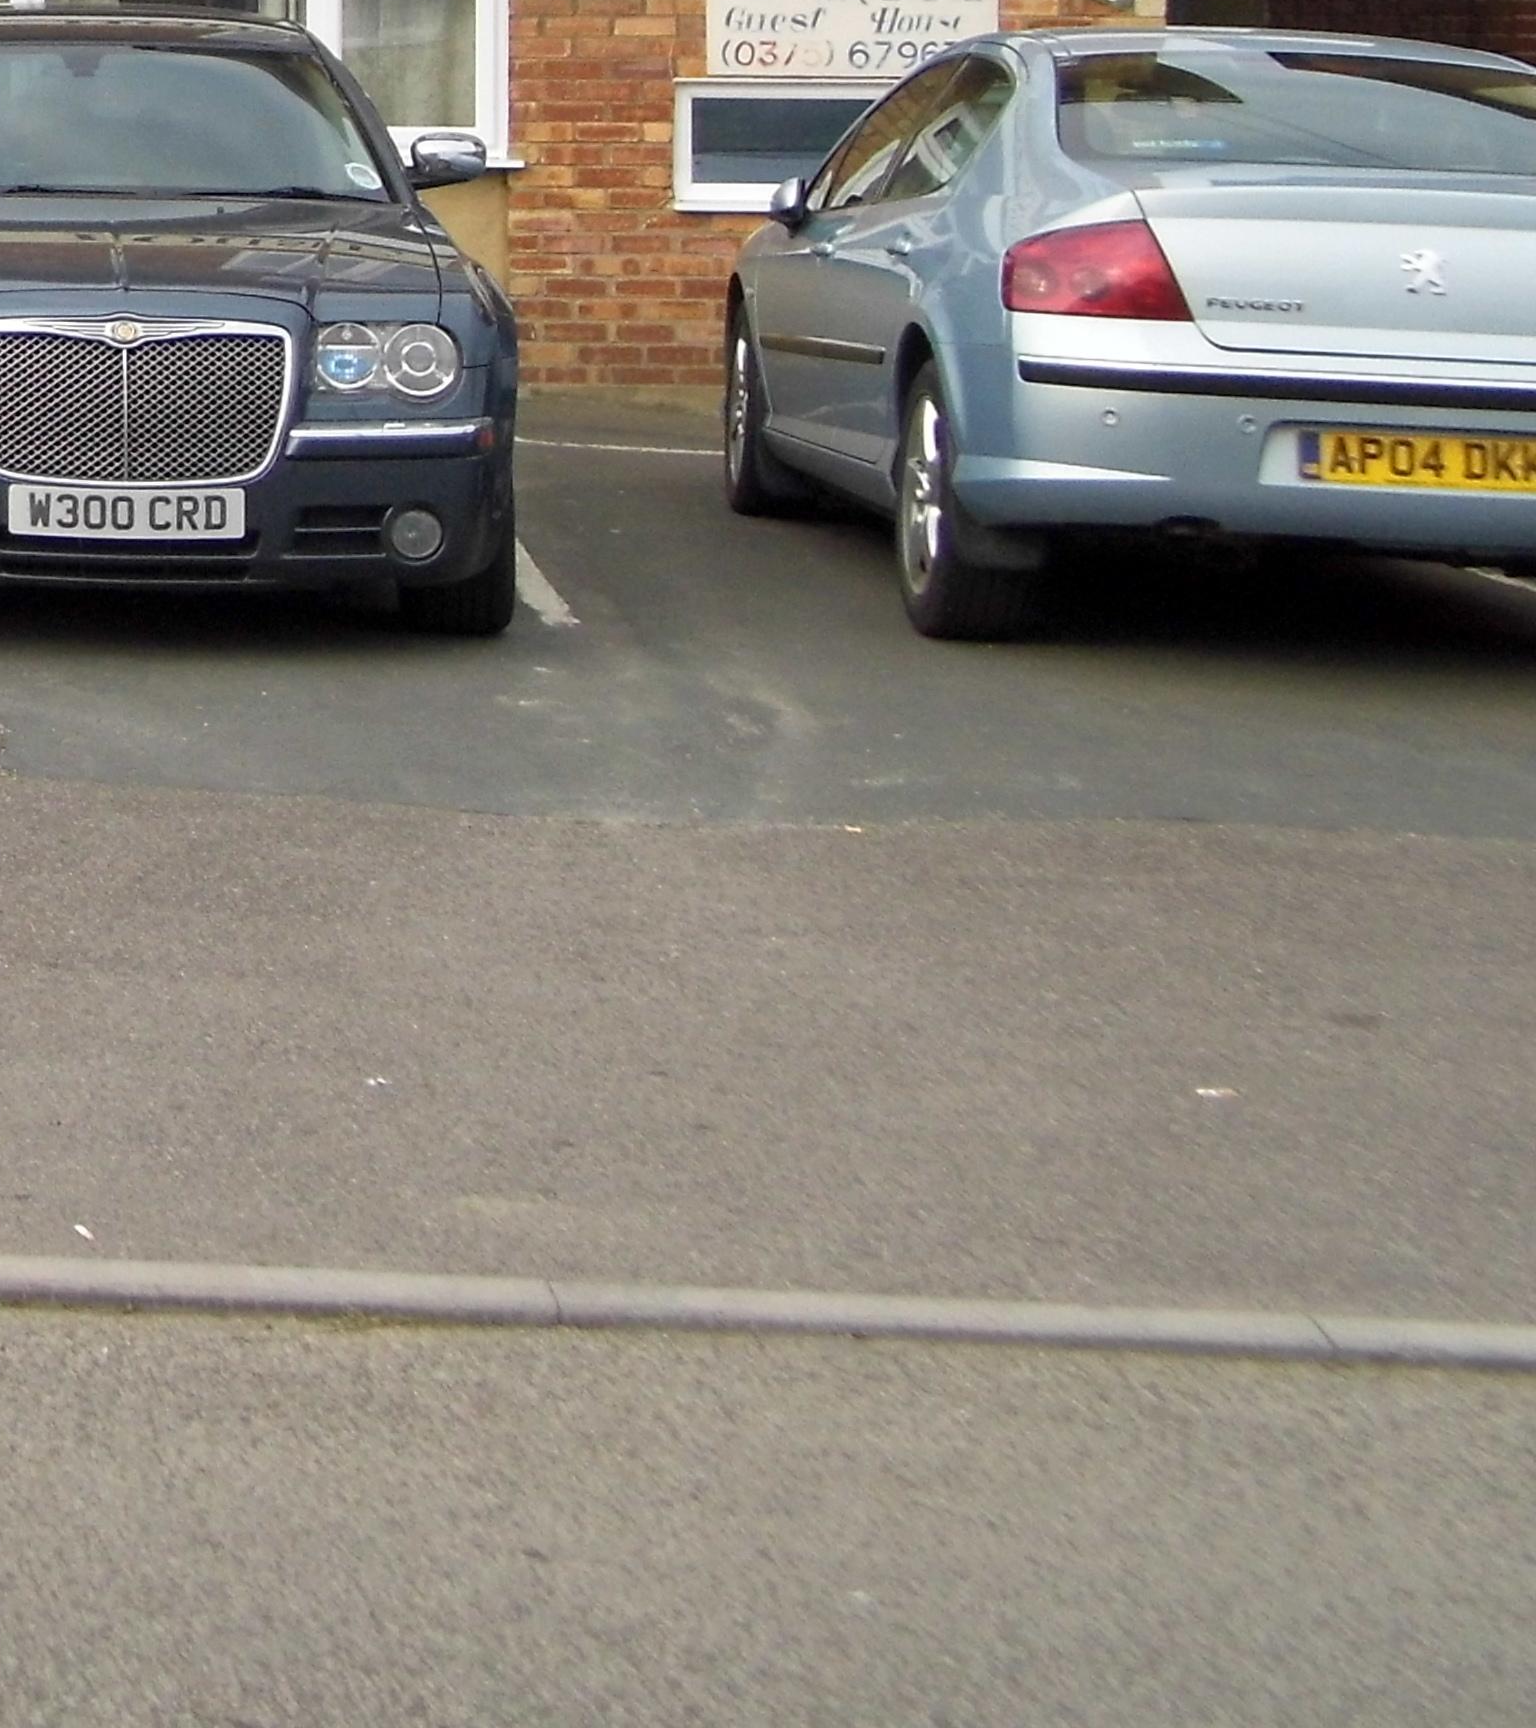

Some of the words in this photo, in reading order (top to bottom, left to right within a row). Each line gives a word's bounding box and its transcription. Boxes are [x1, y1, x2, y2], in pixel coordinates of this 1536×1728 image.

[725, 6, 826, 32] Guest
[870, 7, 962, 35] House
[848, 40, 956, 69] 6796
[1207, 297, 1303, 312] PEUGEOT
[1330, 436, 1445, 478] AP04
[29, 493, 134, 530] W300
[148, 495, 227, 531] CRD
